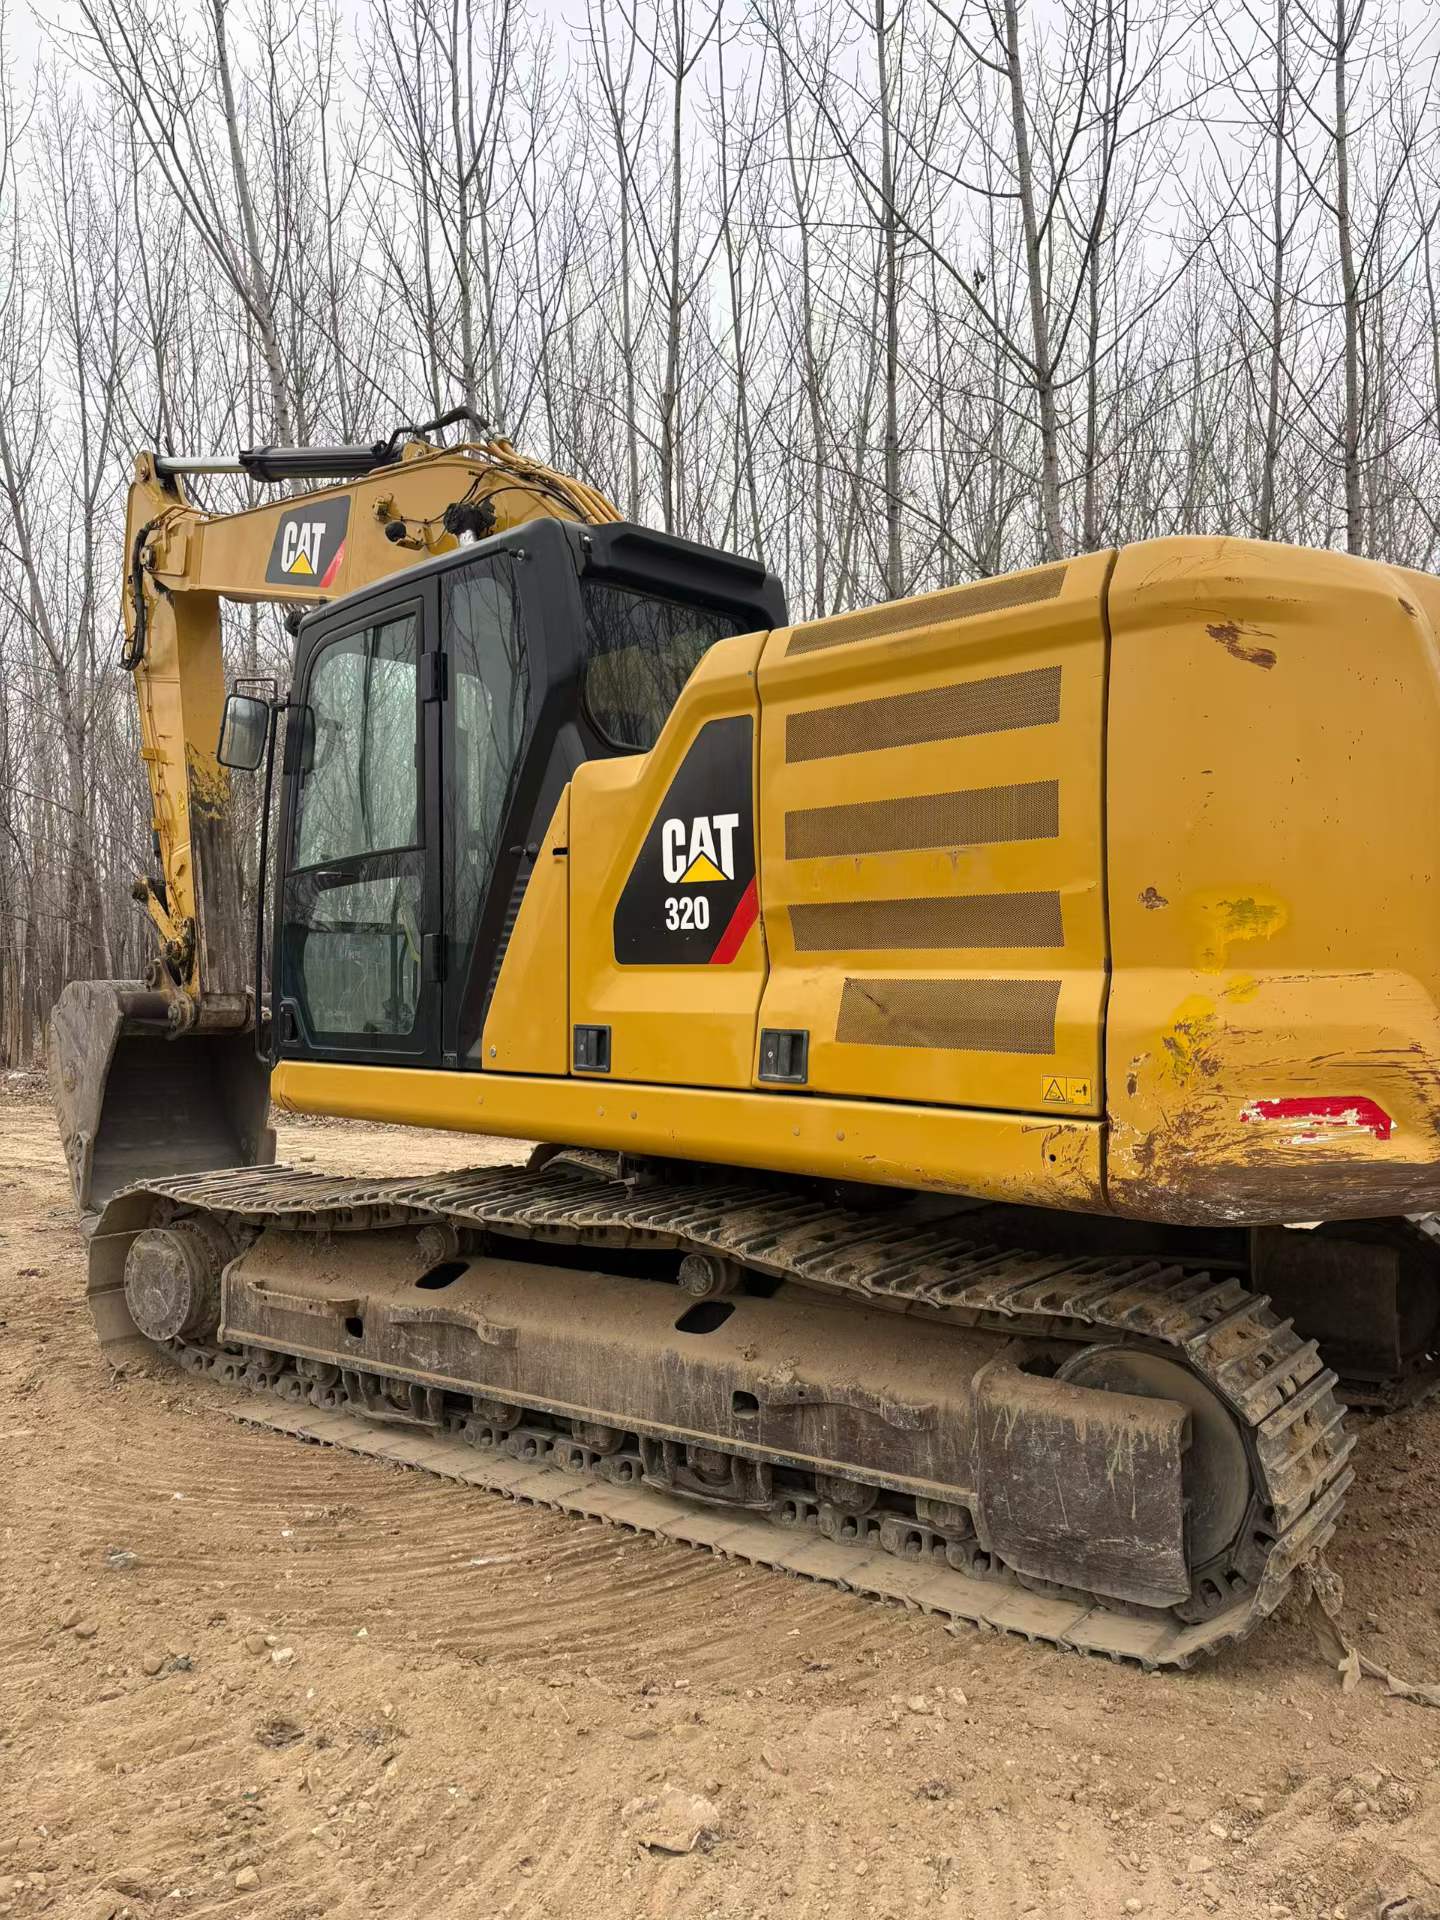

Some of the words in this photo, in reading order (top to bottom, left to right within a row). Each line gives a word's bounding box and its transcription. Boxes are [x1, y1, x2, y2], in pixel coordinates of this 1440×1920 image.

[281, 521, 326, 575] CAT
[662, 813, 739, 884] CAT
[664, 896, 710, 931] 320
